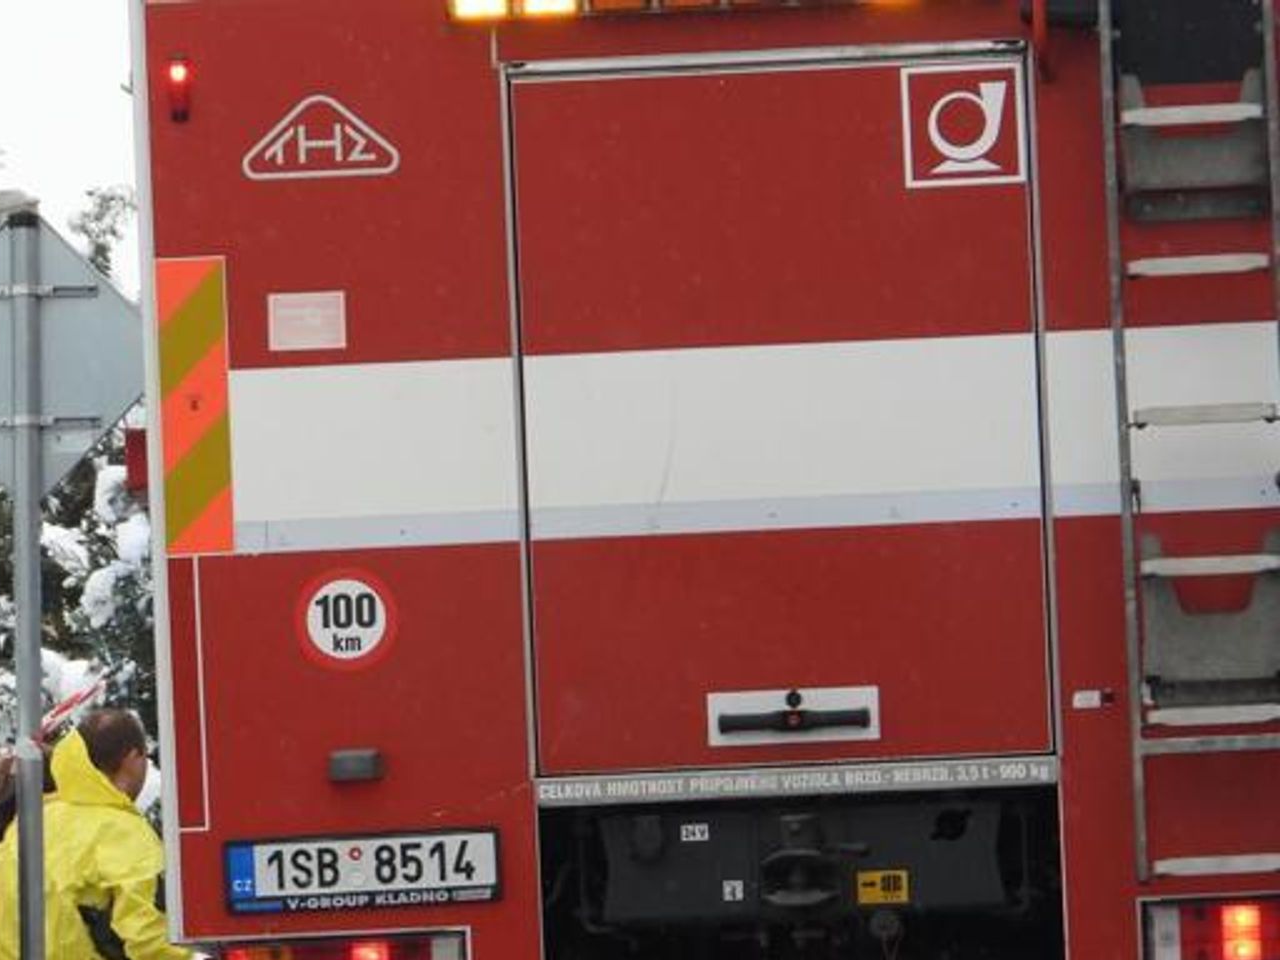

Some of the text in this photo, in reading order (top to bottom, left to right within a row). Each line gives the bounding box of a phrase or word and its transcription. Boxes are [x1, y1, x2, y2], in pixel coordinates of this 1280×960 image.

[315, 593, 376, 629] 100
[332, 633, 362, 652] km
[267, 840, 477, 890] 1SB 8514
[232, 879, 253, 892] CZ
[286, 895, 369, 910] V-GROUP
[375, 890, 450, 905] KLADNO
